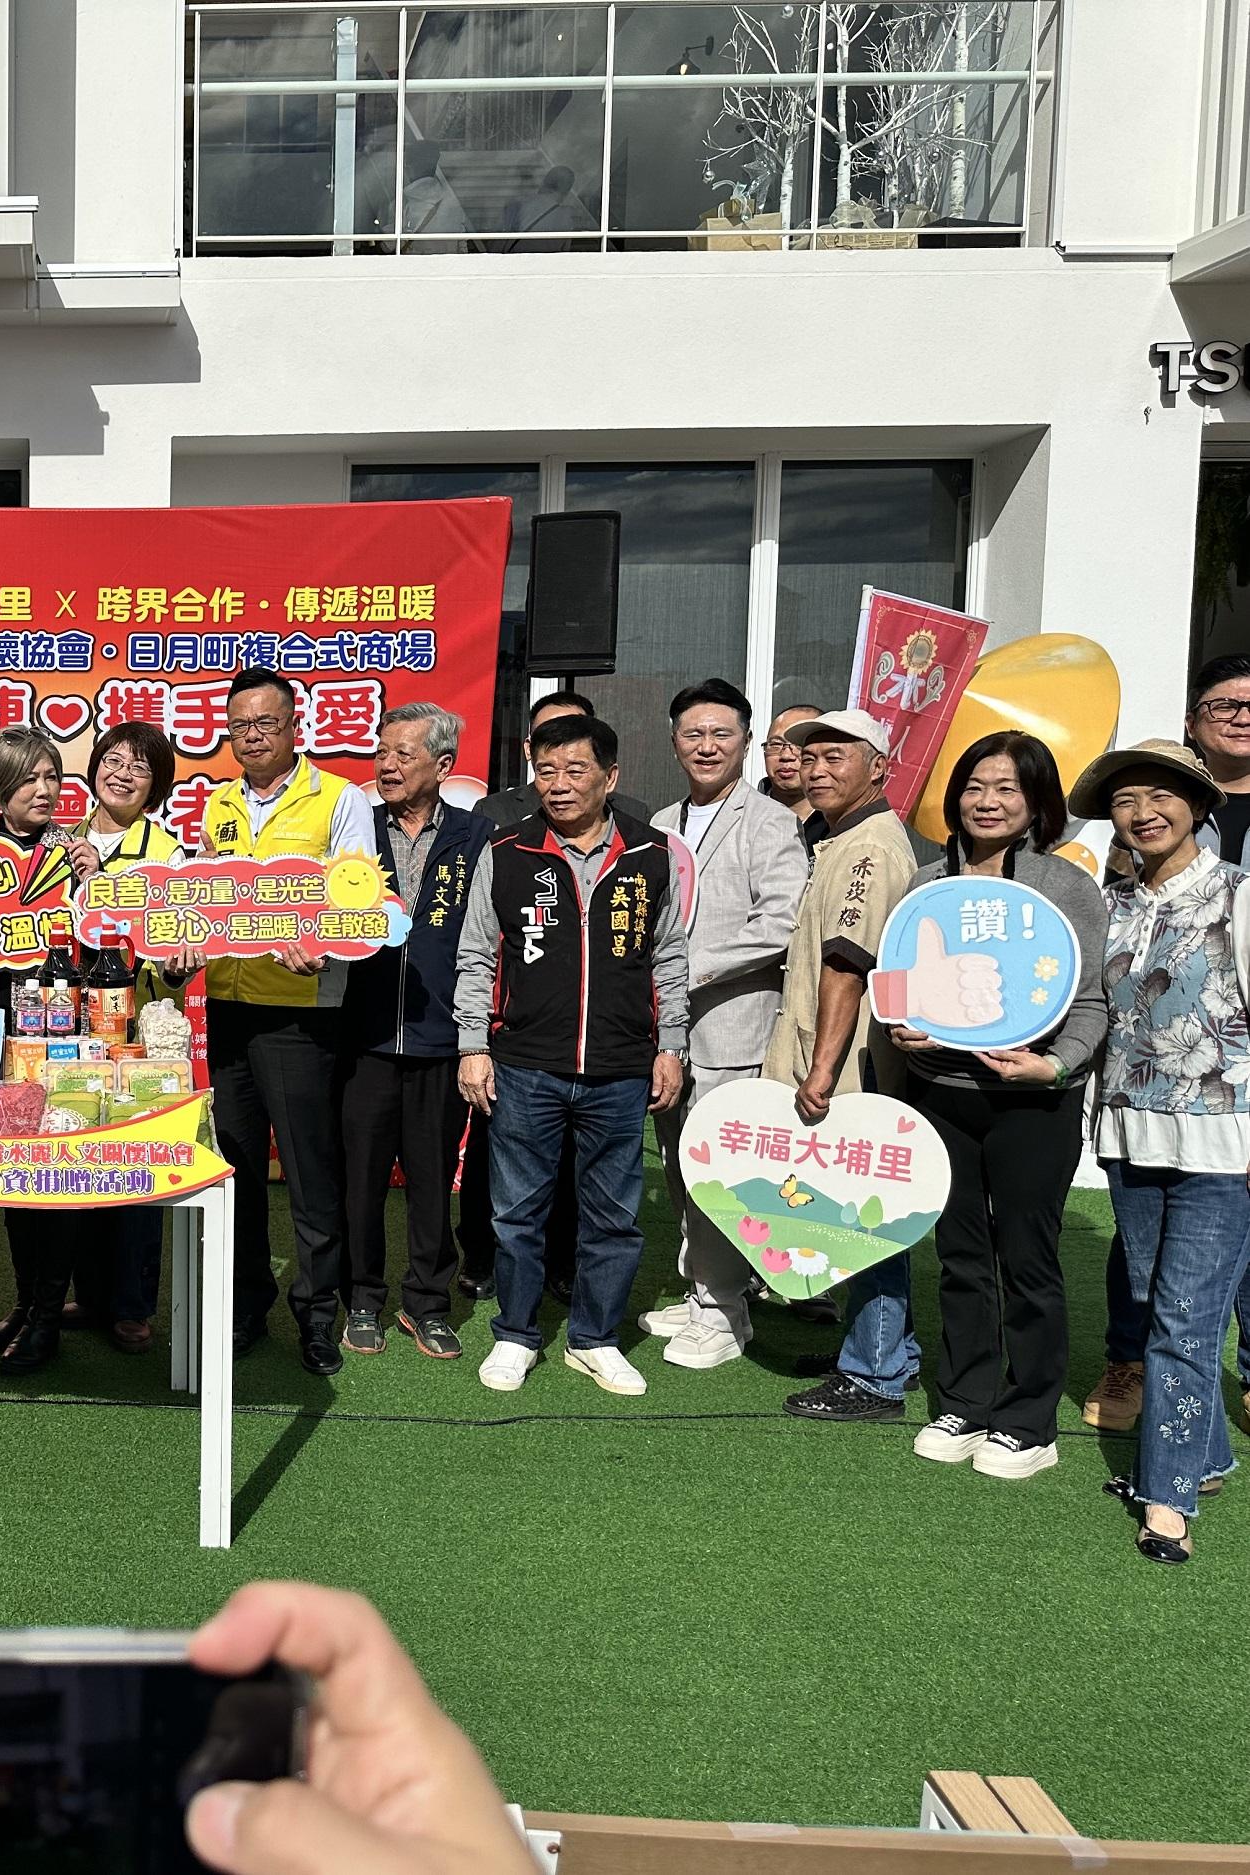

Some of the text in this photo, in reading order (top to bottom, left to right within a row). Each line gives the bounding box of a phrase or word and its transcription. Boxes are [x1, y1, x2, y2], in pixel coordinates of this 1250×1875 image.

[1154, 340, 1250, 395] TS
[428, 864, 452, 927] 馬文君
[610, 886, 632, 958] 吳國昌
[719, 1119, 913, 1184] 幸福大埔里
